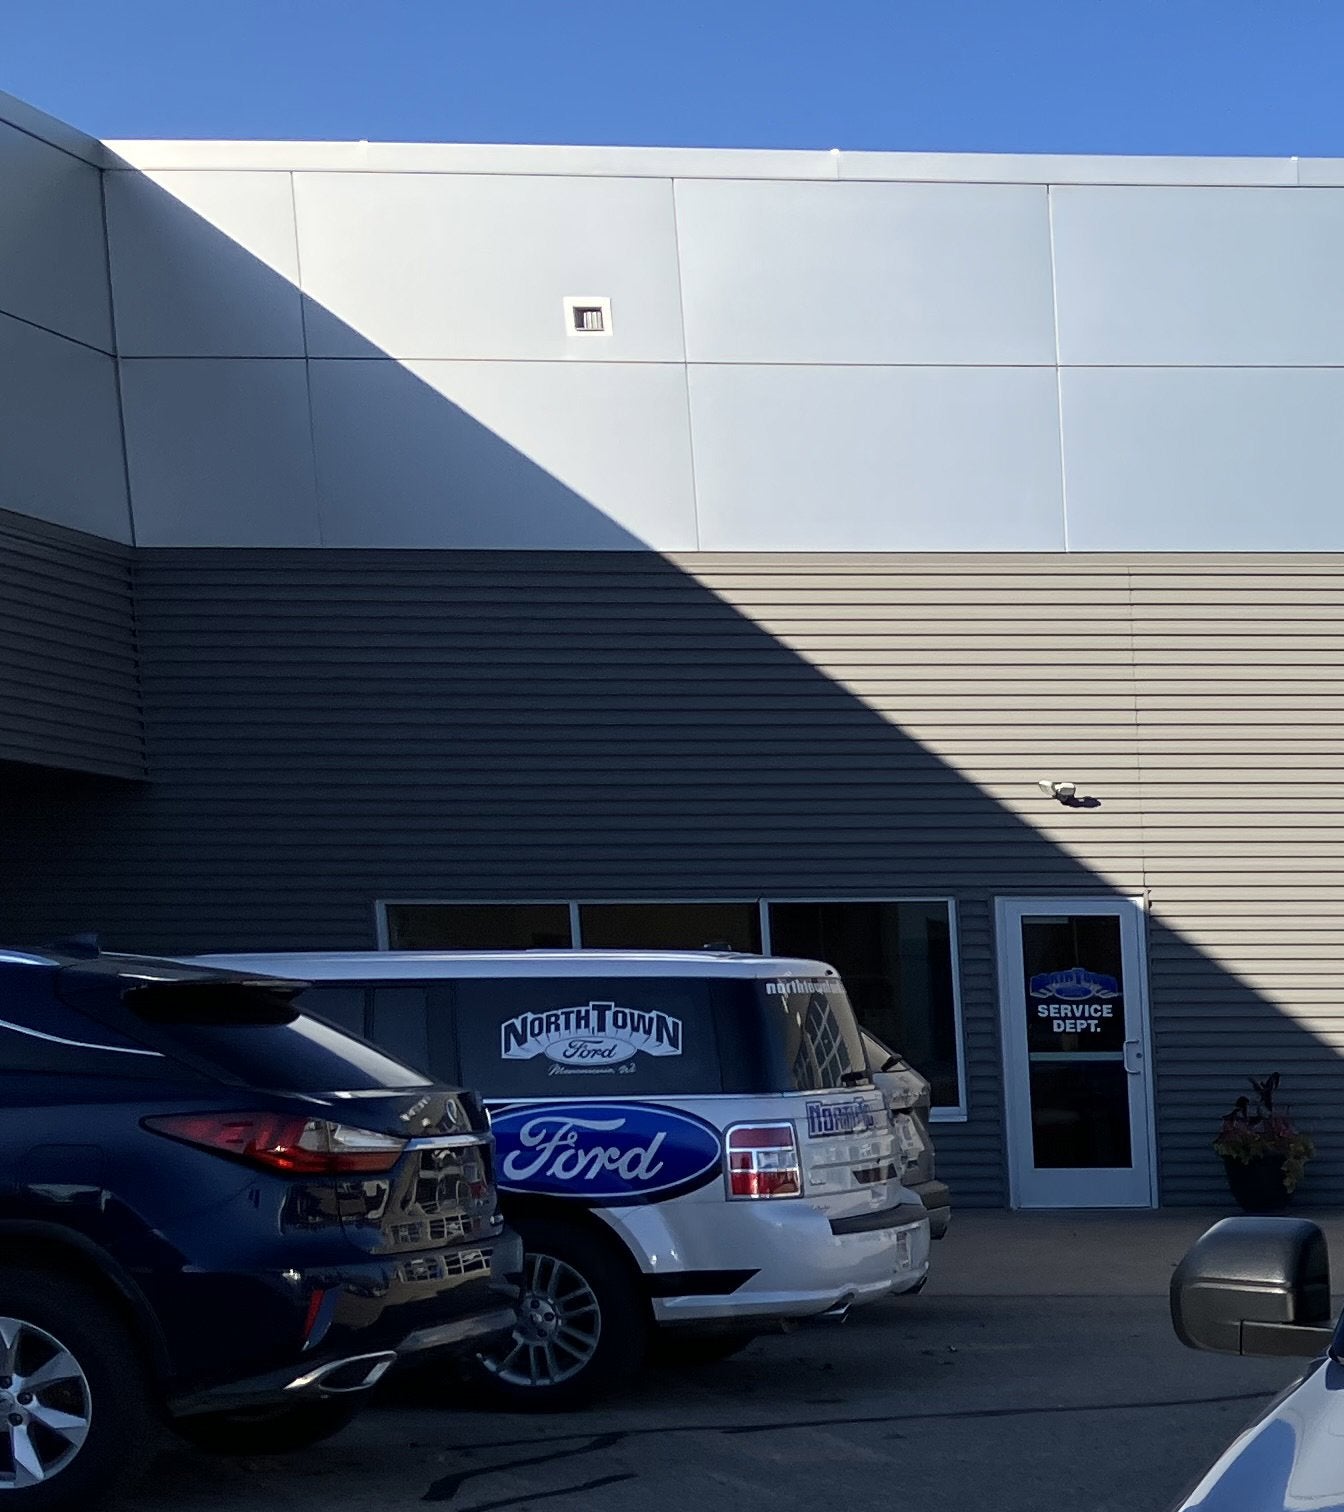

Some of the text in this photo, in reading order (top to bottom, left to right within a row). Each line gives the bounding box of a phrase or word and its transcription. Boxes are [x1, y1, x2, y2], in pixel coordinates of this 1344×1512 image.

[1038, 1004, 1113, 1017] SERVICE
[1053, 1020, 1101, 1032] DEPT.
[562, 1039, 618, 1058] Ford
[503, 1116, 667, 1180] Ford
